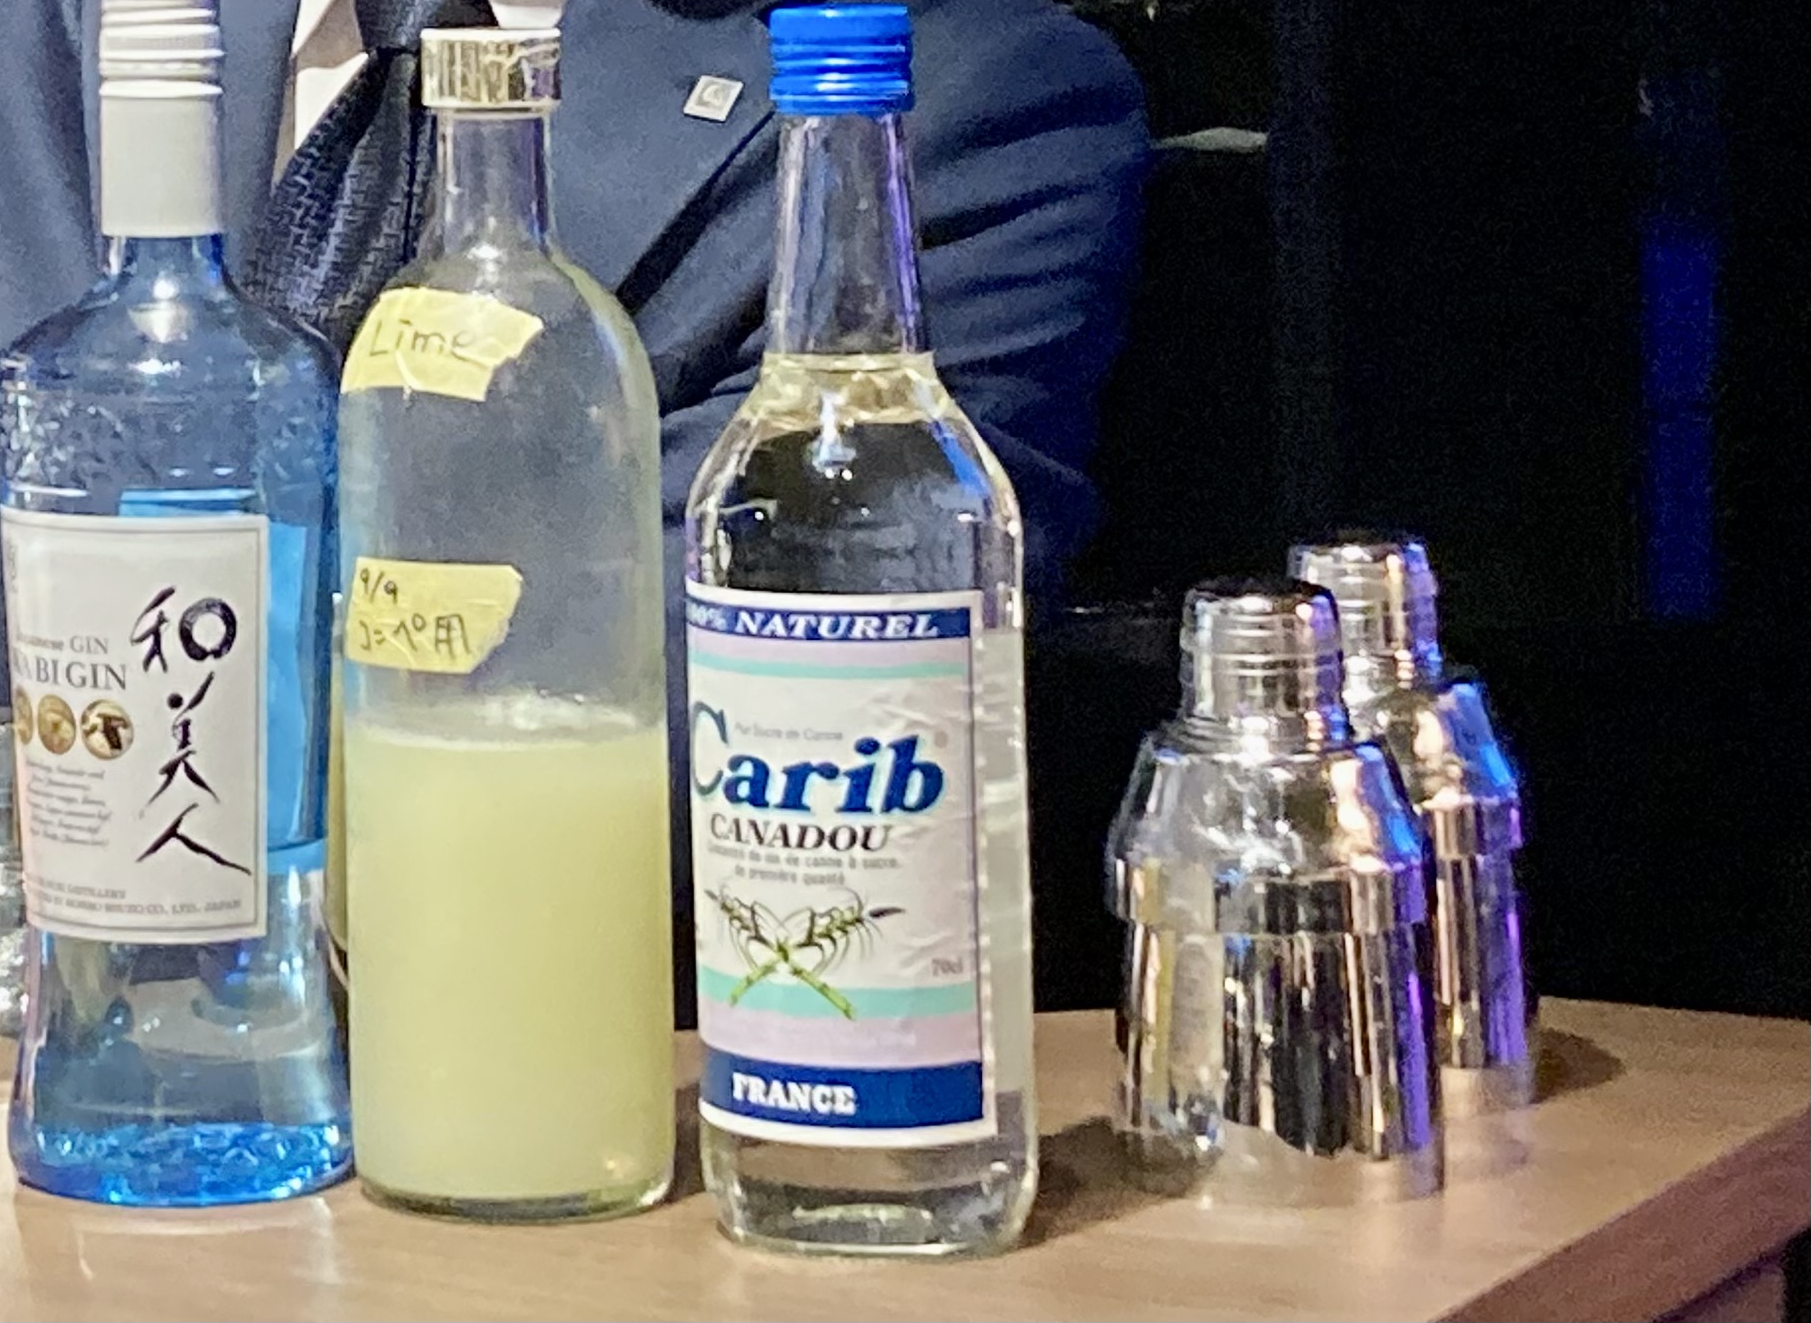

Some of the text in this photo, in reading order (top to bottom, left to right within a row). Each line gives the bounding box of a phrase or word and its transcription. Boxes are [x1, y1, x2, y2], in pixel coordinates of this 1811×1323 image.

[369, 318, 477, 359] Lime
[686, 599, 939, 640] 00% NATUREL
[69, 635, 110, 655] GIN
[65, 661, 127, 691] GIN
[131, 584, 253, 876] 和美人
[690, 700, 944, 813] Carib
[710, 812, 893, 852] CANADOU
[731, 1071, 858, 1116] FRANCE
